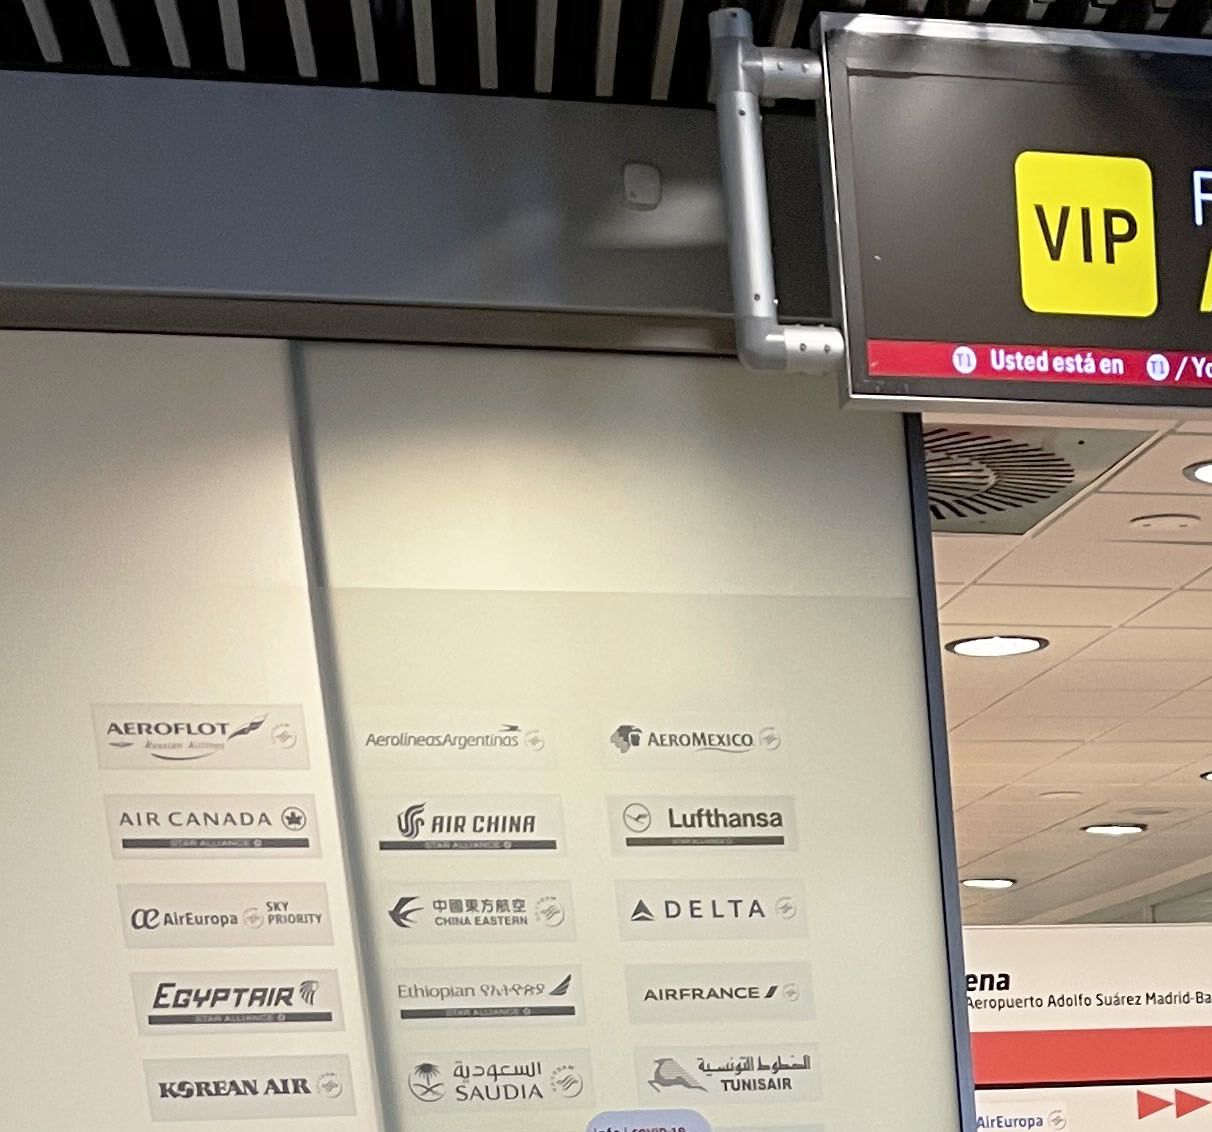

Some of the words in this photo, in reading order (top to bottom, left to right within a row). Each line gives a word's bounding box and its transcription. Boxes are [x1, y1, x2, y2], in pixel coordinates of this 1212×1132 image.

[1033, 203, 1138, 265] VIP
[990, 349, 1048, 372] Usted
[1053, 352, 1095, 374] está
[1100, 356, 1124, 375] en
[106, 722, 230, 735] AEROFLOT
[120, 812, 160, 826] AIR
[168, 812, 272, 826] CANADA
[431, 815, 466, 833] AIR
[472, 815, 536, 833] CHINA
[669, 808, 783, 828] Lufthansa
[266, 901, 289, 912] SKY
[664, 899, 766, 918] DELTA
[163, 912, 238, 928] AirEuropa
[268, 913, 322, 925] PRIORITY
[434, 916, 472, 926] CHINA
[475, 916, 528, 926] EASTERN
[966, 971, 1011, 992] ena
[397, 984, 475, 1001] Ethiopian
[643, 987, 760, 1001] AIRFRANCE
[966, 995, 1043, 1011] Aeropuerto
[1048, 993, 1092, 1008] Adolfo
[1096, 992, 1142, 1007] Suárez
[453, 1060, 542, 1083] السعودية
[159, 1079, 259, 1098] KOREAN
[263, 1078, 312, 1095] AIR
[456, 1084, 543, 1102] SAUDIA
[721, 1077, 792, 1092] TUNISAIR
[976, 1115, 1044, 1132] AirEuropa
